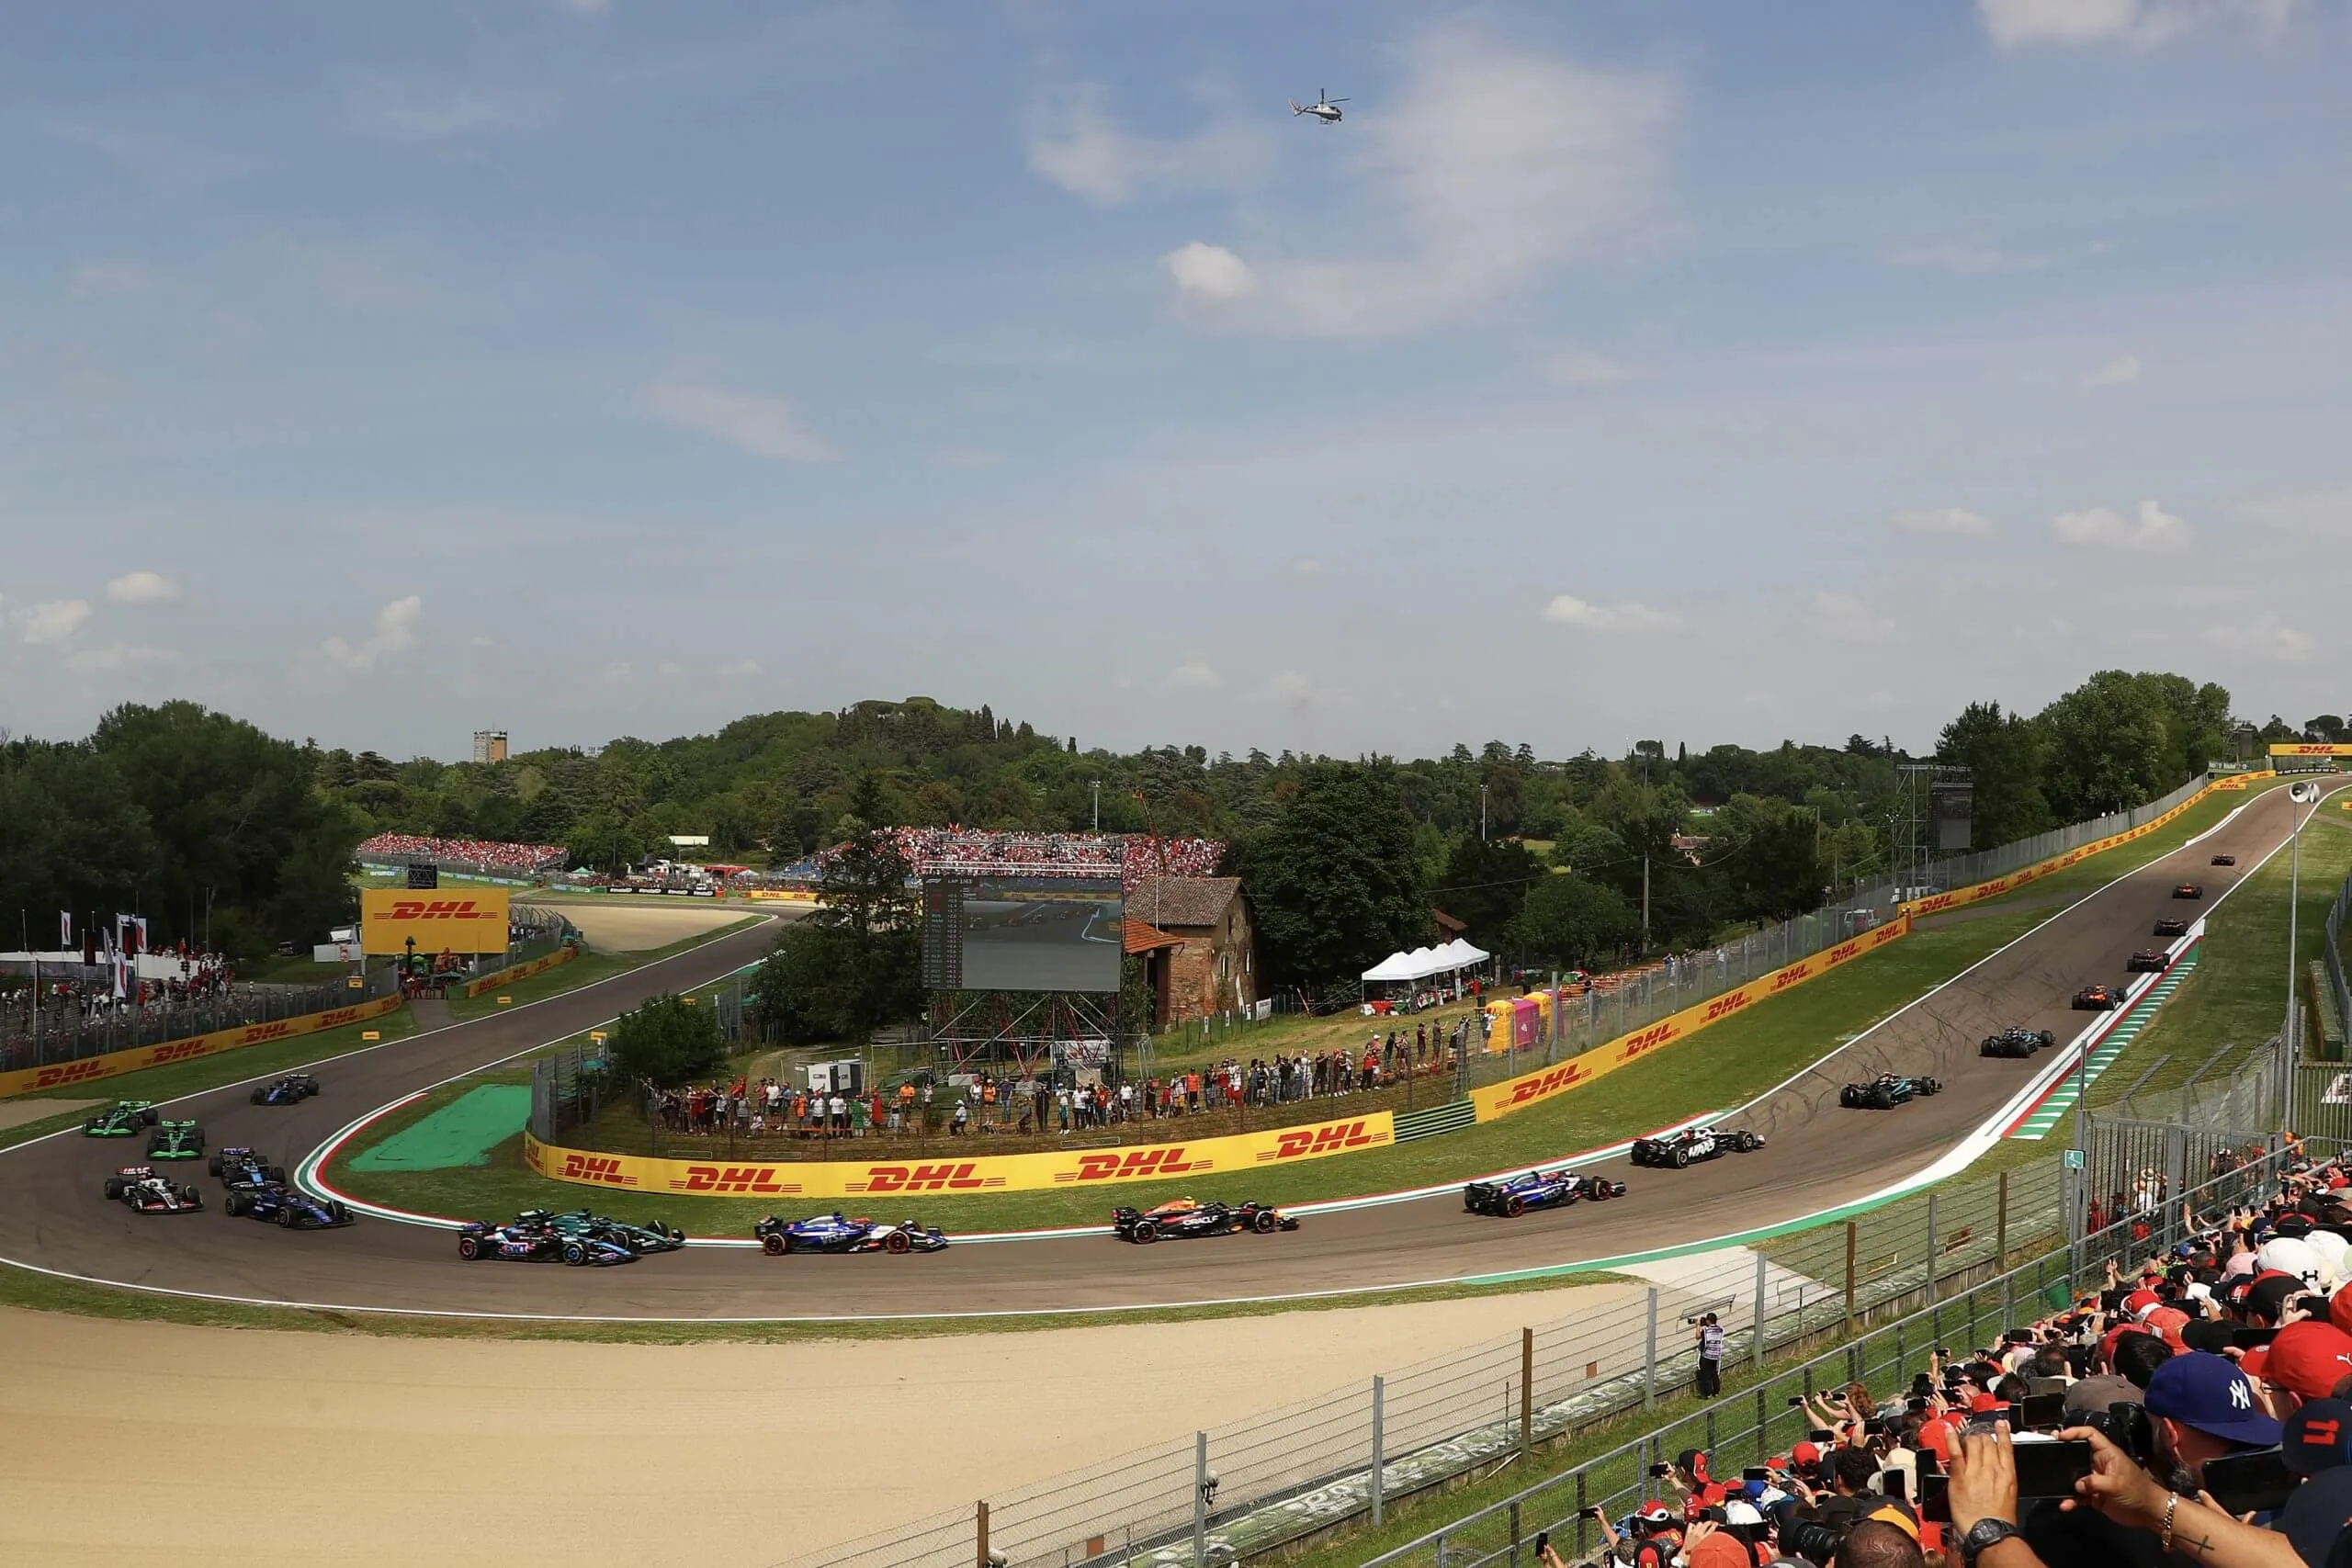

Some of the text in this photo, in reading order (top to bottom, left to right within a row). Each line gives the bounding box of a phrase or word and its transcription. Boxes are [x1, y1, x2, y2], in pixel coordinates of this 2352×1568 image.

[2018, 871, 2032, 883] DHL
[2042, 862, 2056, 873] DHL
[1977, 881, 2009, 897] DHL
[391, 901, 481, 919] DHL
[1919, 895, 1954, 913] DHL
[1876, 924, 1899, 944] DHL
[1830, 942, 1857, 964] DHL
[1776, 964, 1812, 988] DHL
[322, 1009, 358, 1026] DHL
[1707, 992, 1745, 1021] DHL
[245, 1022, 291, 1043] DHL
[1624, 1023, 1672, 1057] DHL
[153, 1040, 209, 1064] DHL
[37, 1061, 105, 1088] DHL
[1512, 1065, 1582, 1103] DHL
[1276, 1122, 1372, 1158] DHL
[564, 1154, 625, 1184] DHL
[1077, 1148, 1192, 1180] DHL
[686, 1167, 782, 1192] DHL
[867, 1164, 984, 1191] DHL
[1182, 1214, 1219, 1225] ORACLE
